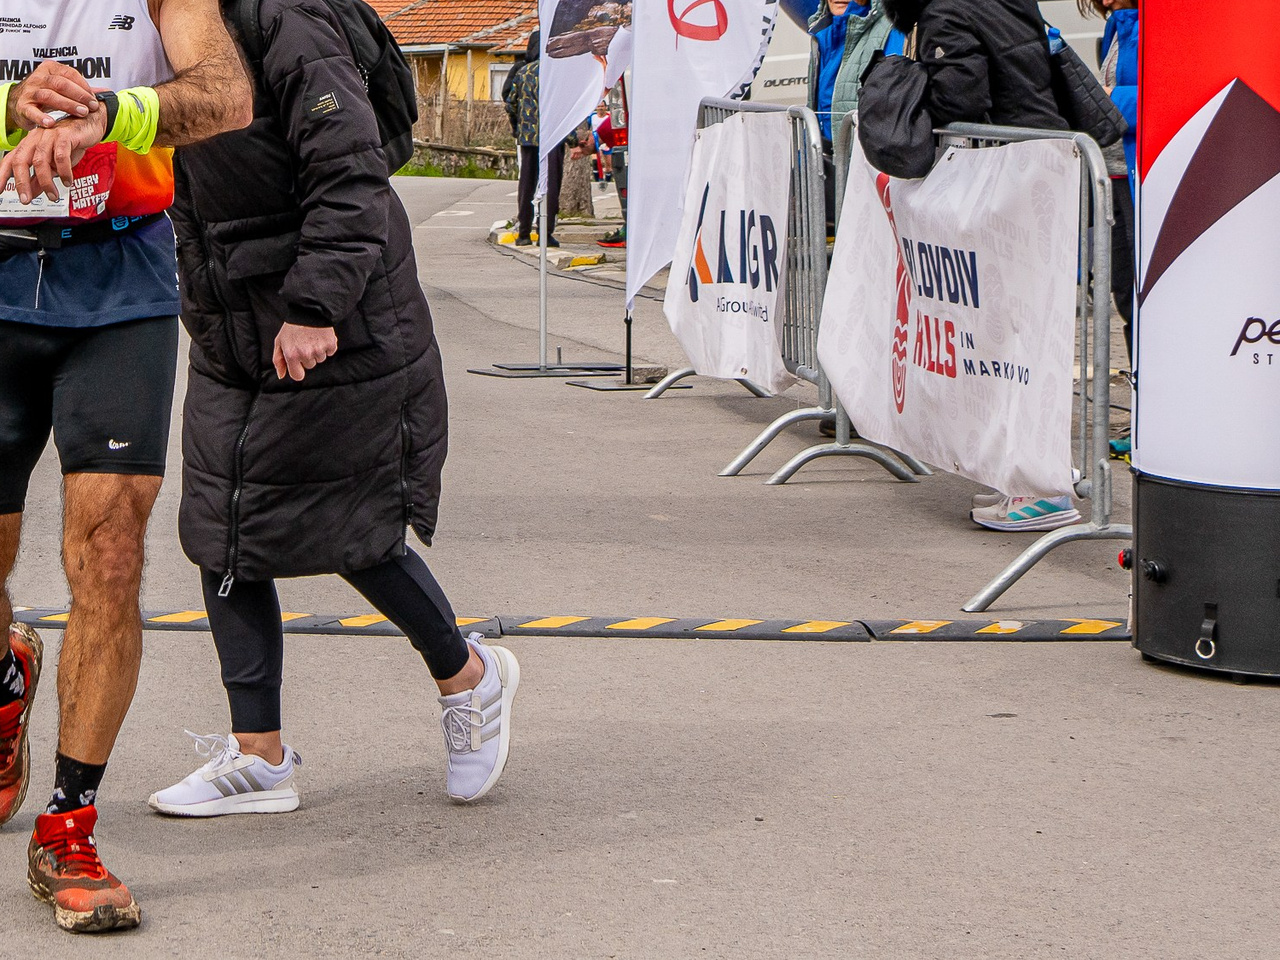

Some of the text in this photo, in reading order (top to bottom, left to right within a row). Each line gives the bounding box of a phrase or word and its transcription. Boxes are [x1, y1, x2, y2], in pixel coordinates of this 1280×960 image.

[32, 46, 78, 58] VALENCIA
[70, 174, 99, 190] EVERY
[70, 187, 95, 200] STEP
[902, 236, 980, 309] PLOVDIV
[960, 331, 975, 350] IN
[963, 358, 1030, 386] MARKOVO
